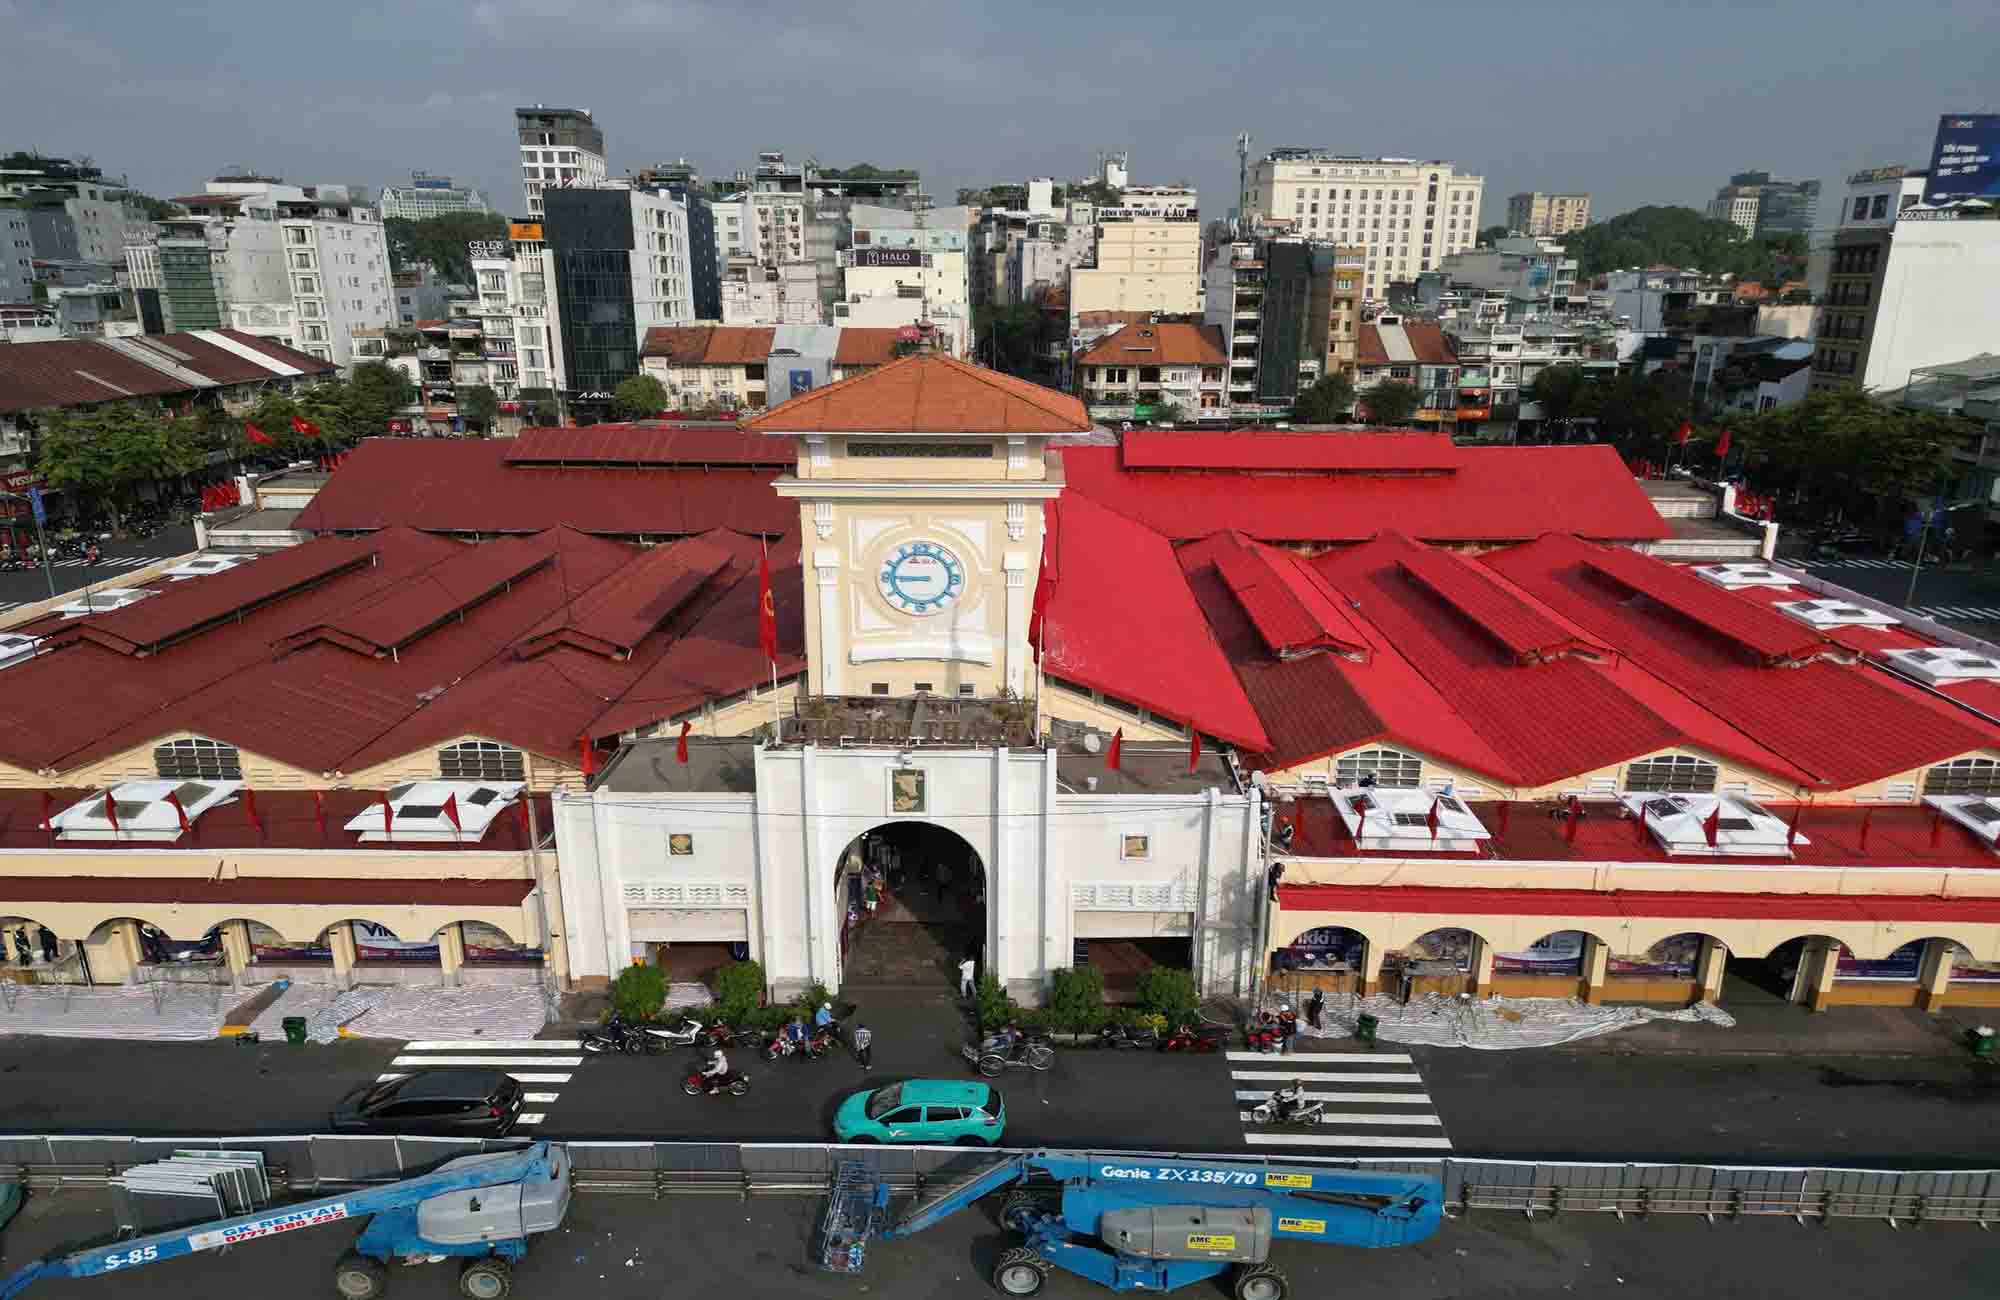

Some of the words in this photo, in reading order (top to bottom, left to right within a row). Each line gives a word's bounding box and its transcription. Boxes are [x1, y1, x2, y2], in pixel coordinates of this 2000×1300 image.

[1896, 211, 1935, 220] OZONE
[1936, 210, 1960, 220] BAR
[468, 240, 504, 249] CELEB
[470, 249, 489, 257] SPA
[881, 252, 910, 261] HALO
[1101, 1166, 1151, 1181] Genie
[1156, 1168, 1257, 1185] ZX-135/70
[1267, 1174, 1288, 1183] AMC
[222, 1224, 250, 1237] GK
[259, 1205, 343, 1228] RENTAL
[1281, 1218, 1303, 1227] AMC
[225, 1228, 267, 1243] 0777
[312, 1211, 345, 1224] 222
[1189, 1236, 1211, 1245] AMC
[104, 1245, 158, 1270] S-85
